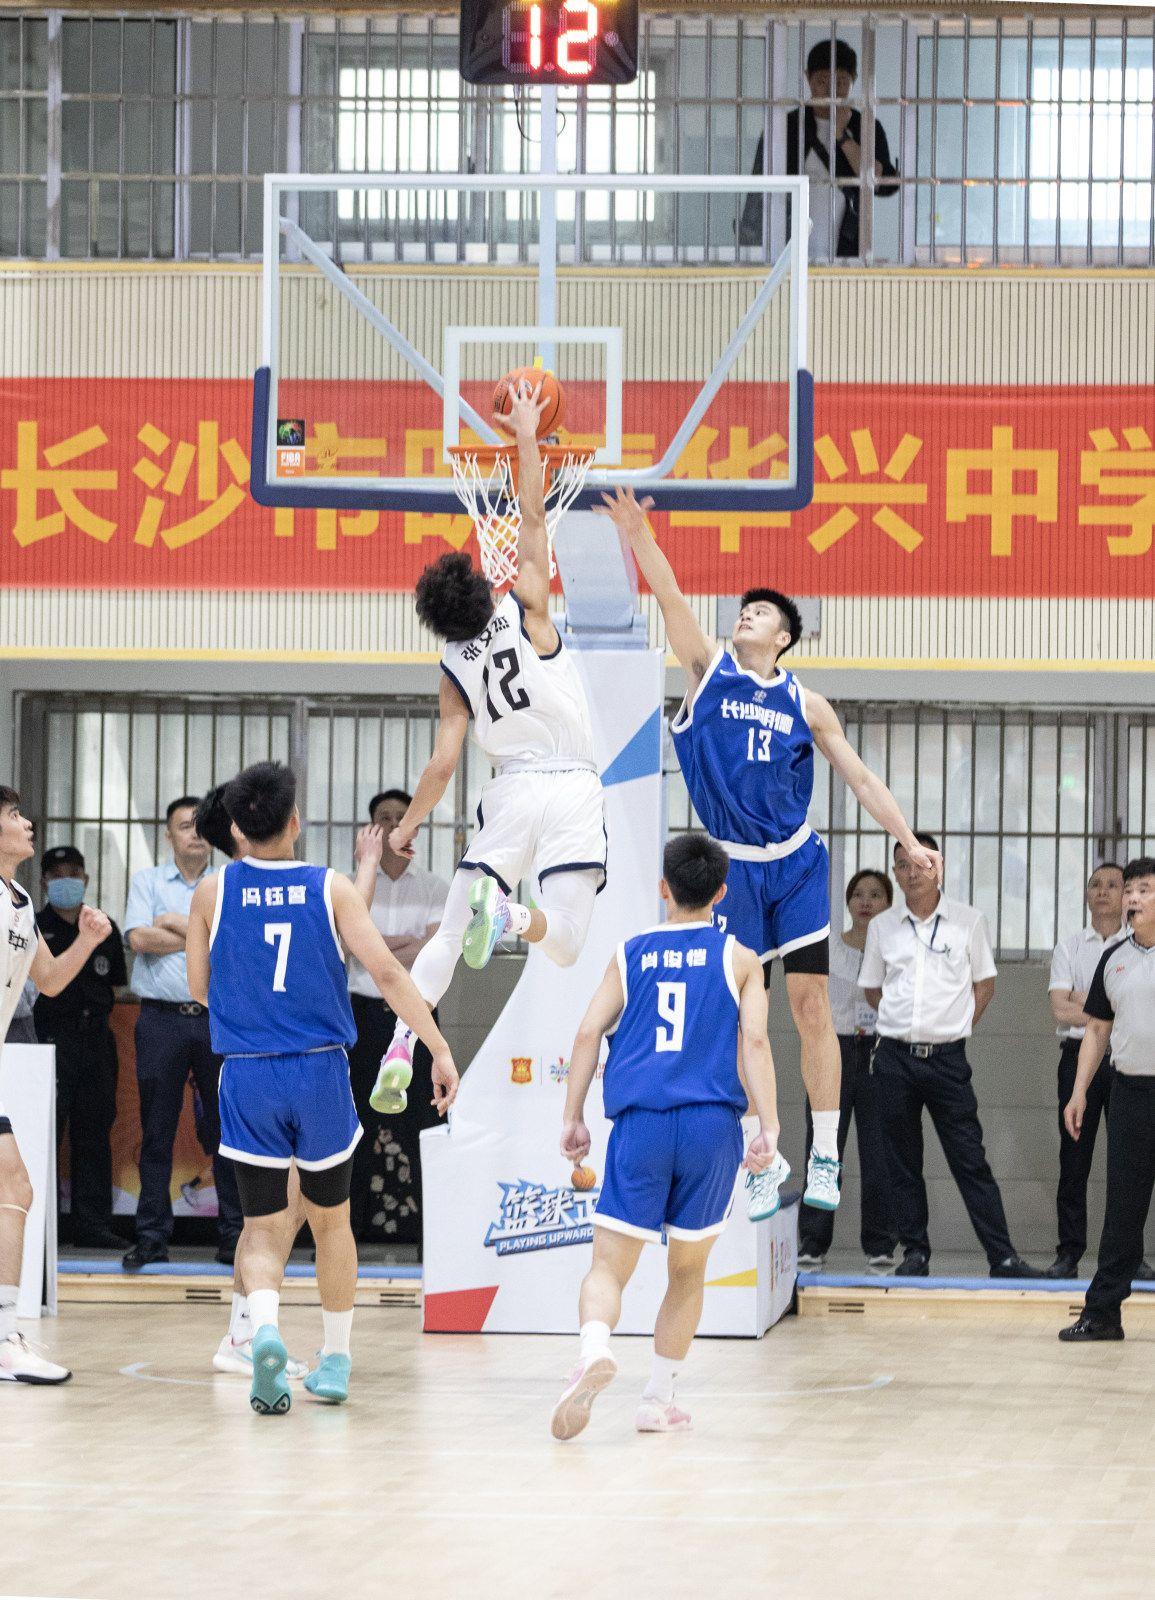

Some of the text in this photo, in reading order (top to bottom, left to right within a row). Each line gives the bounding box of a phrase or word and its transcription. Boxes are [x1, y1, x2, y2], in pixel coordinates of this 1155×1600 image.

[530, 0, 599, 75] 12
[482, 647, 531, 723] 12
[747, 727, 772, 762] 13
[264, 922, 292, 992] 7
[655, 981, 687, 1053] 9
[500, 1234, 546, 1251] PLAYING
